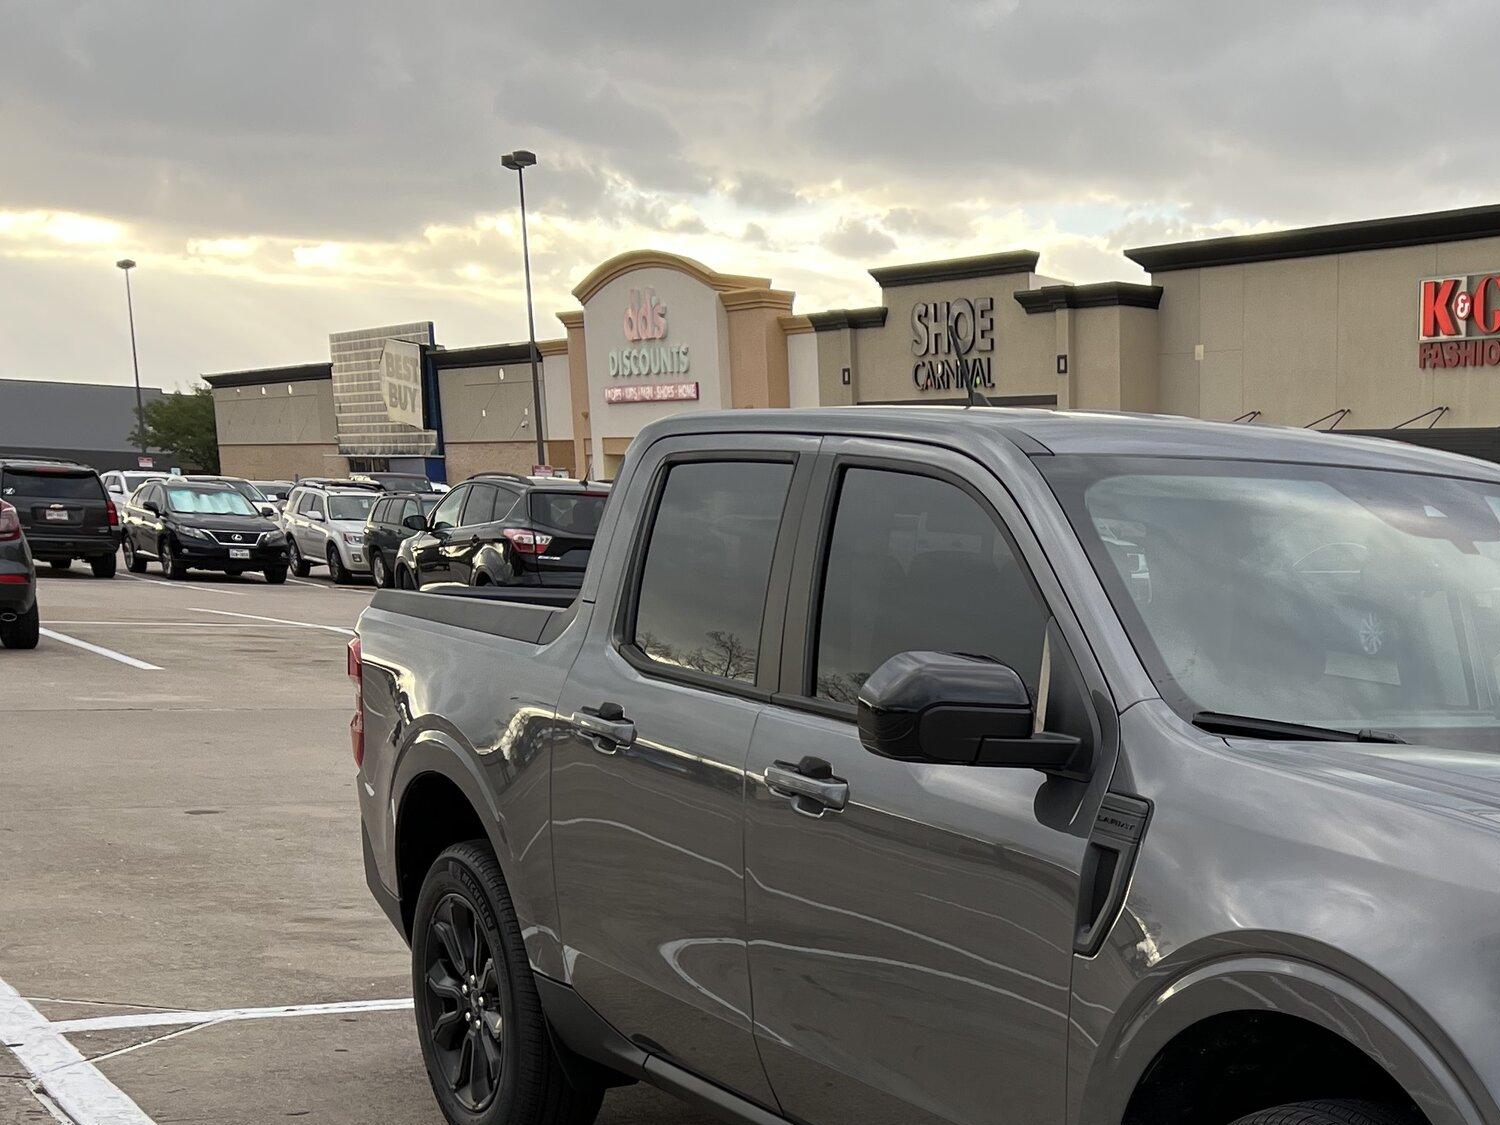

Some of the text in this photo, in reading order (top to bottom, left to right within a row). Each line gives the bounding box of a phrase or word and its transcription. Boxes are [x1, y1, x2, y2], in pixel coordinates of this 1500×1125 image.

[911, 297, 994, 357] SHOE
[608, 345, 690, 377] DISCOUNTS
[389, 383, 419, 413] BUY
